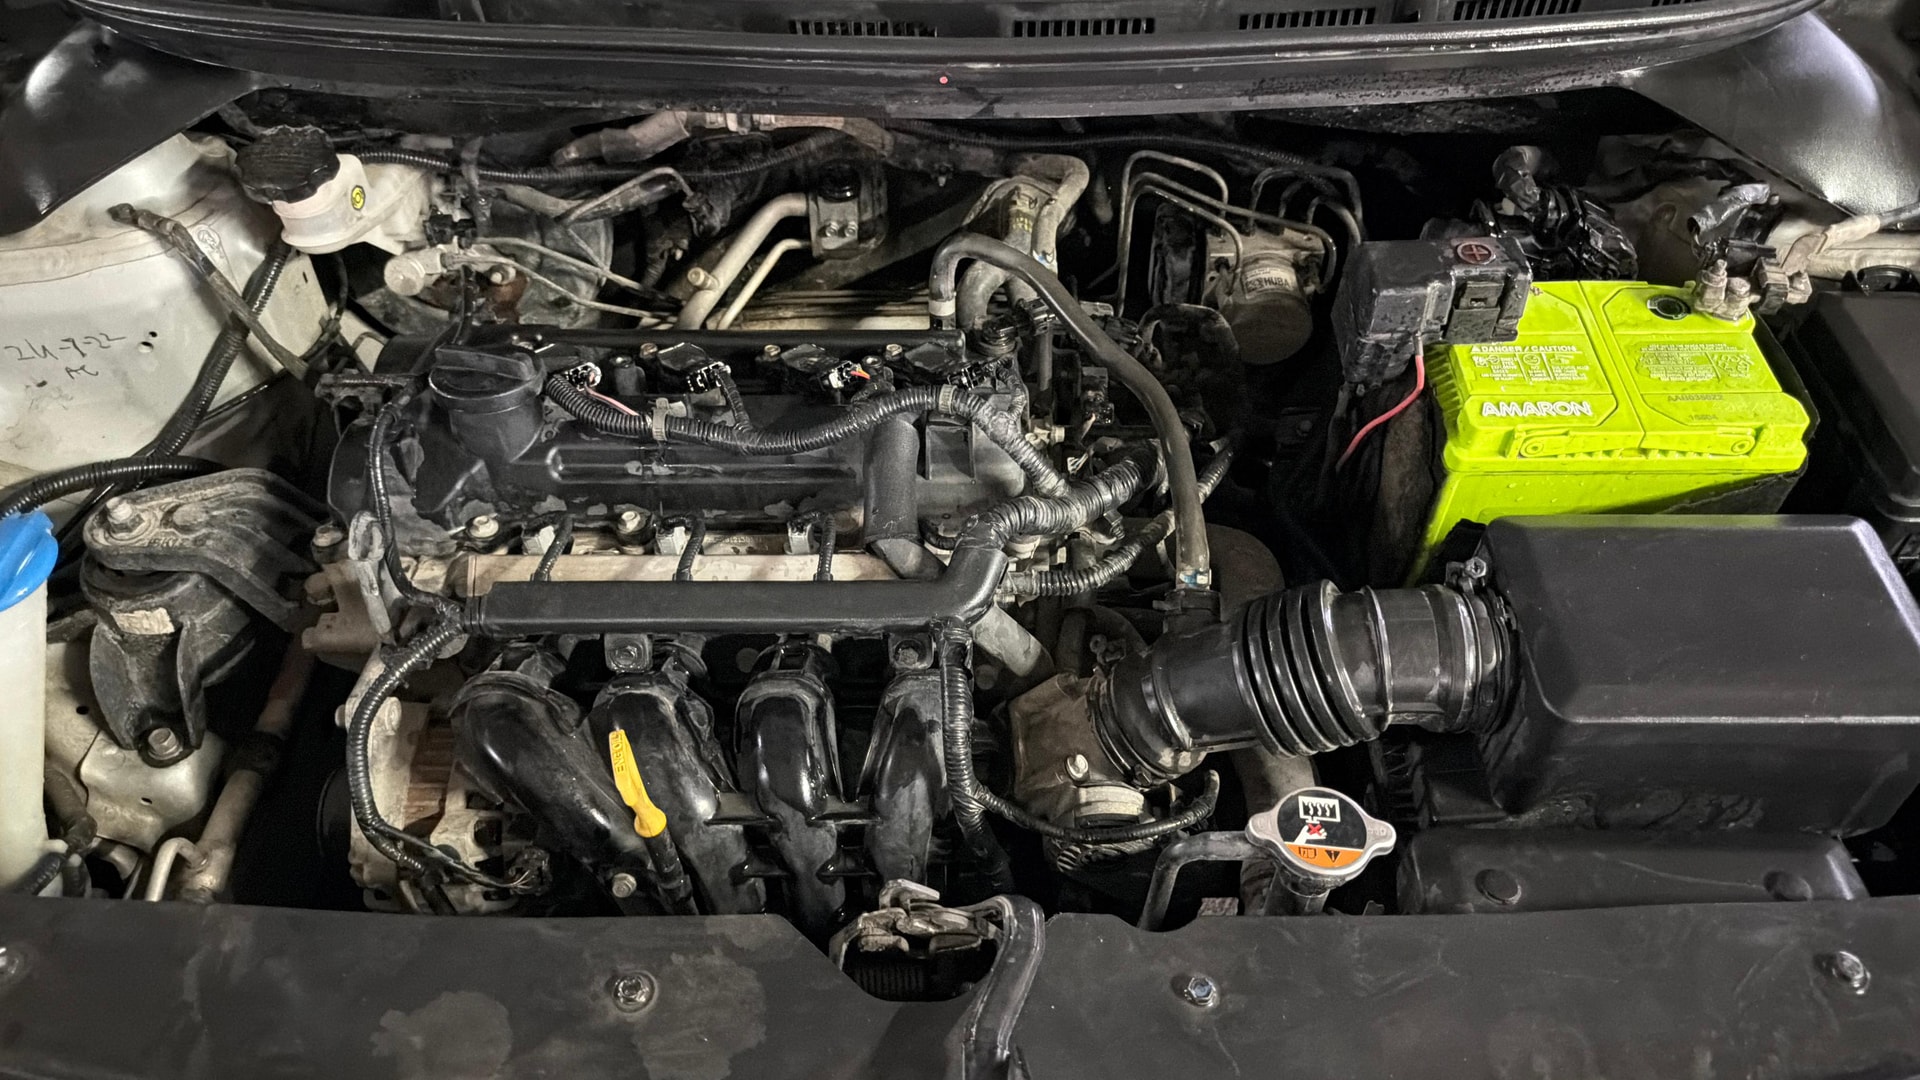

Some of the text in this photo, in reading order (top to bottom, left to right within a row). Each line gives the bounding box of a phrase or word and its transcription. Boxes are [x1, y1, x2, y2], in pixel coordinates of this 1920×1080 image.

[1481, 345, 1521, 353] DANGER
[1531, 345, 1577, 353] CAUTION
[1481, 400, 1593, 417] AMARON
